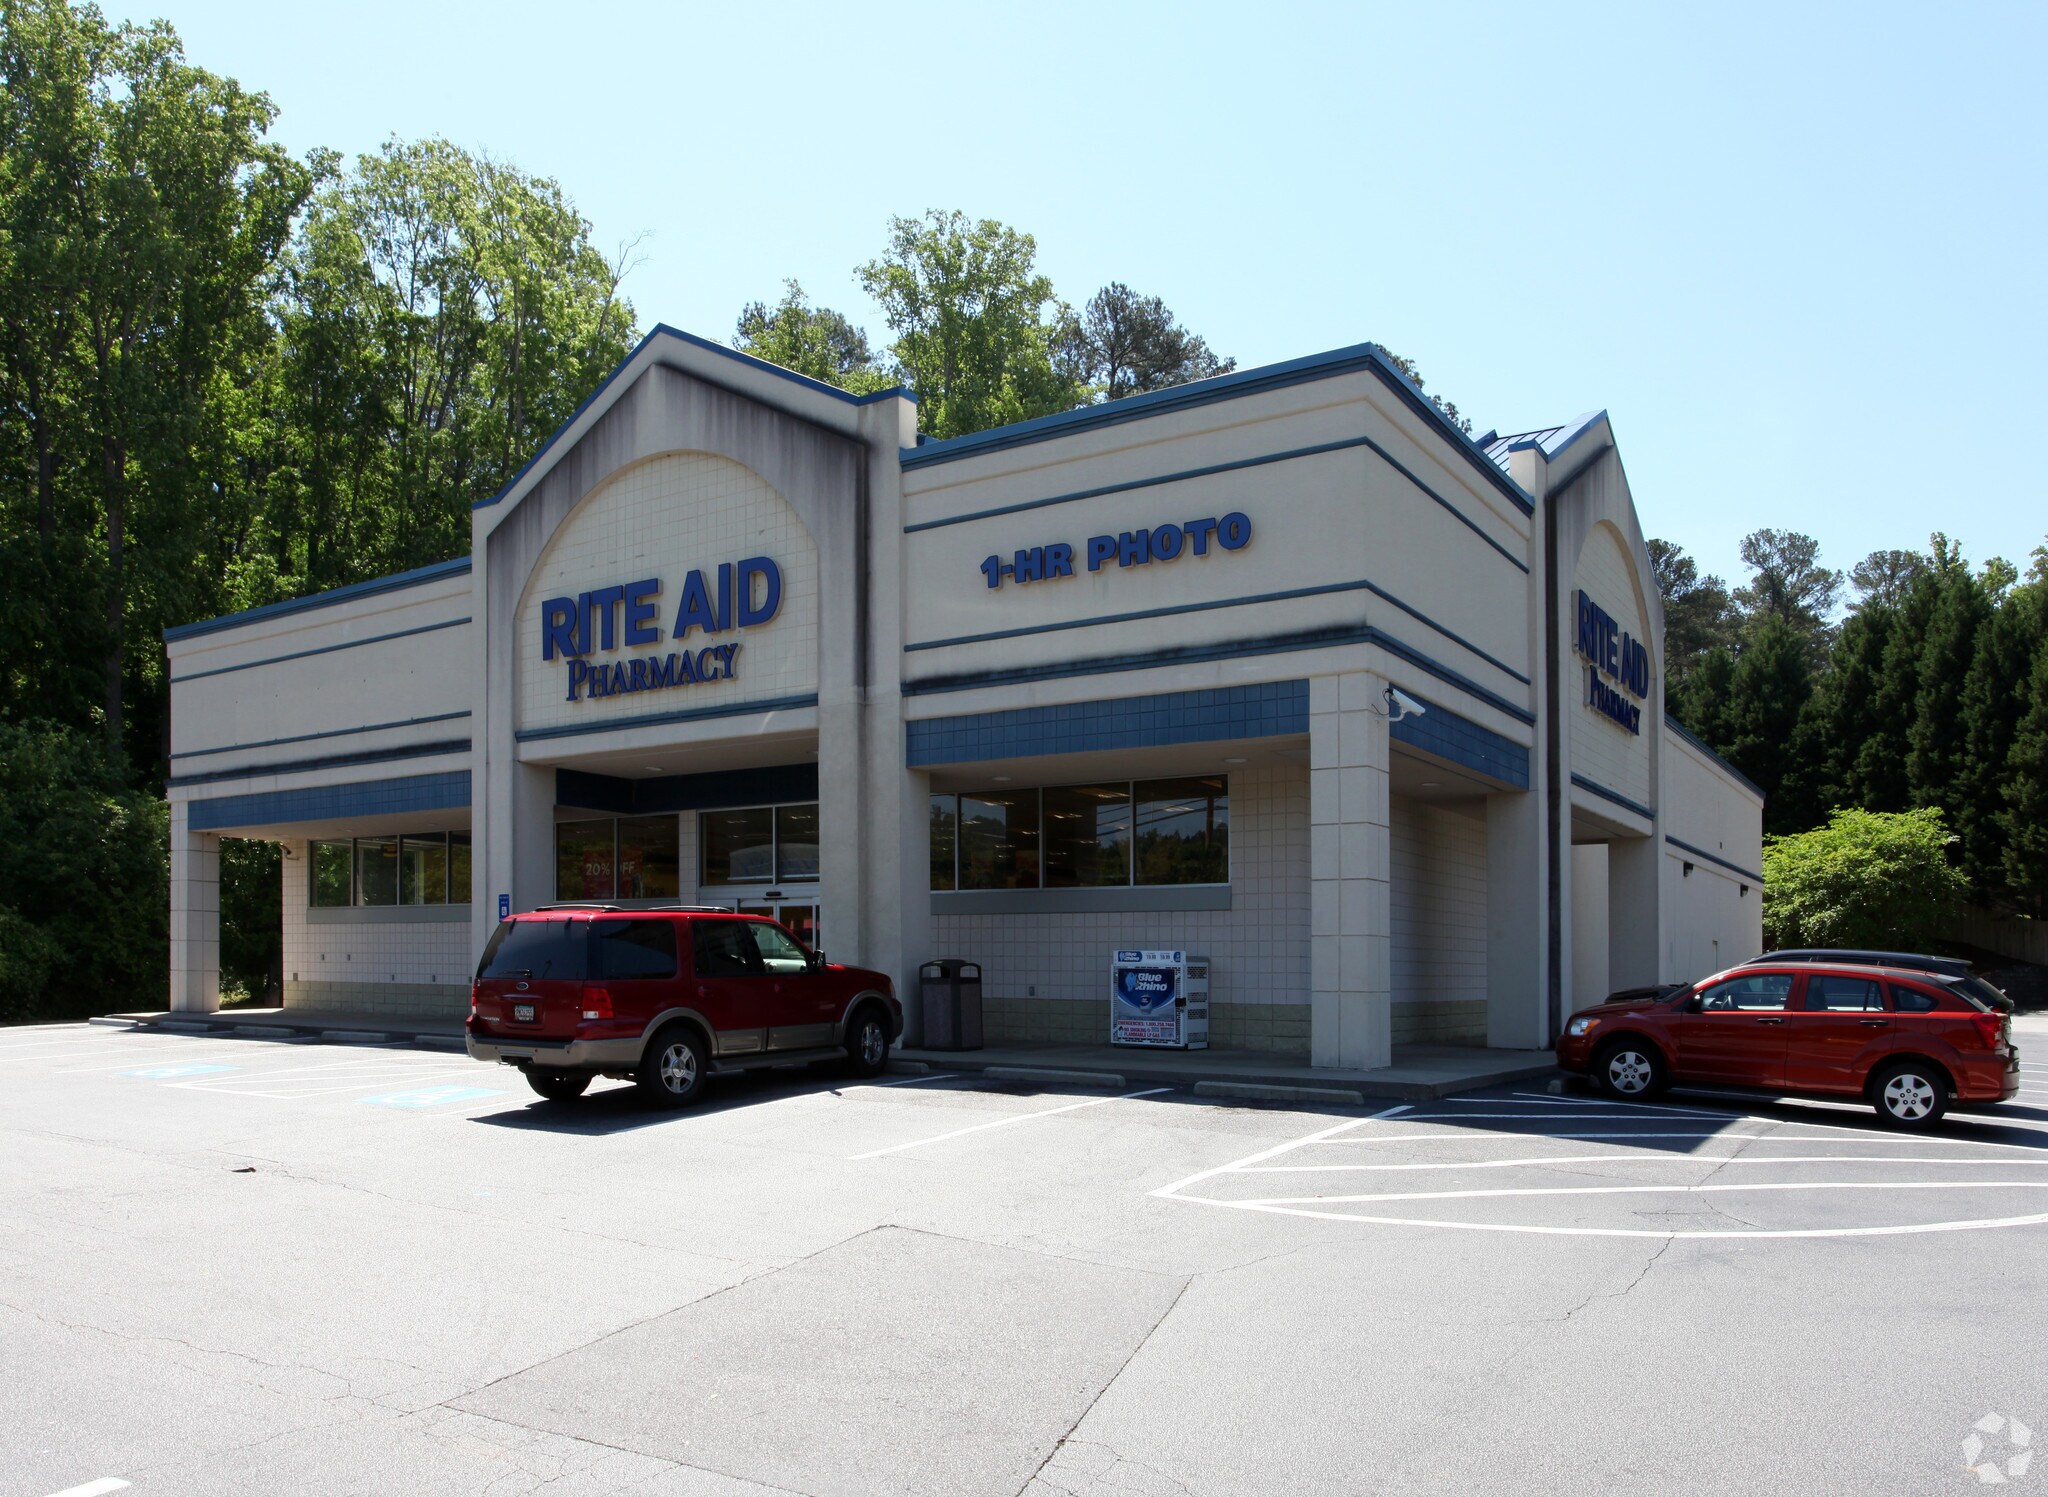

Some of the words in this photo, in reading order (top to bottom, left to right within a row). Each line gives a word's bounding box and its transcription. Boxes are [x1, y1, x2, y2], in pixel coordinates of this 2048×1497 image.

[980, 543, 1074, 589] 1-HR
[1088, 511, 1252, 572] PHOTO
[541, 577, 661, 661] RITE
[672, 556, 782, 639] AID
[566, 642, 739, 701] PHARMACY
[1577, 589, 1619, 681] RITE
[1619, 631, 1649, 699] AID
[1588, 664, 1641, 736] PHARMACY
[585, 863, 610, 876] 20%
[621, 861, 636, 875] FF
[1135, 982, 1168, 992] Rhino
[1138, 973, 1162, 982] Blue
